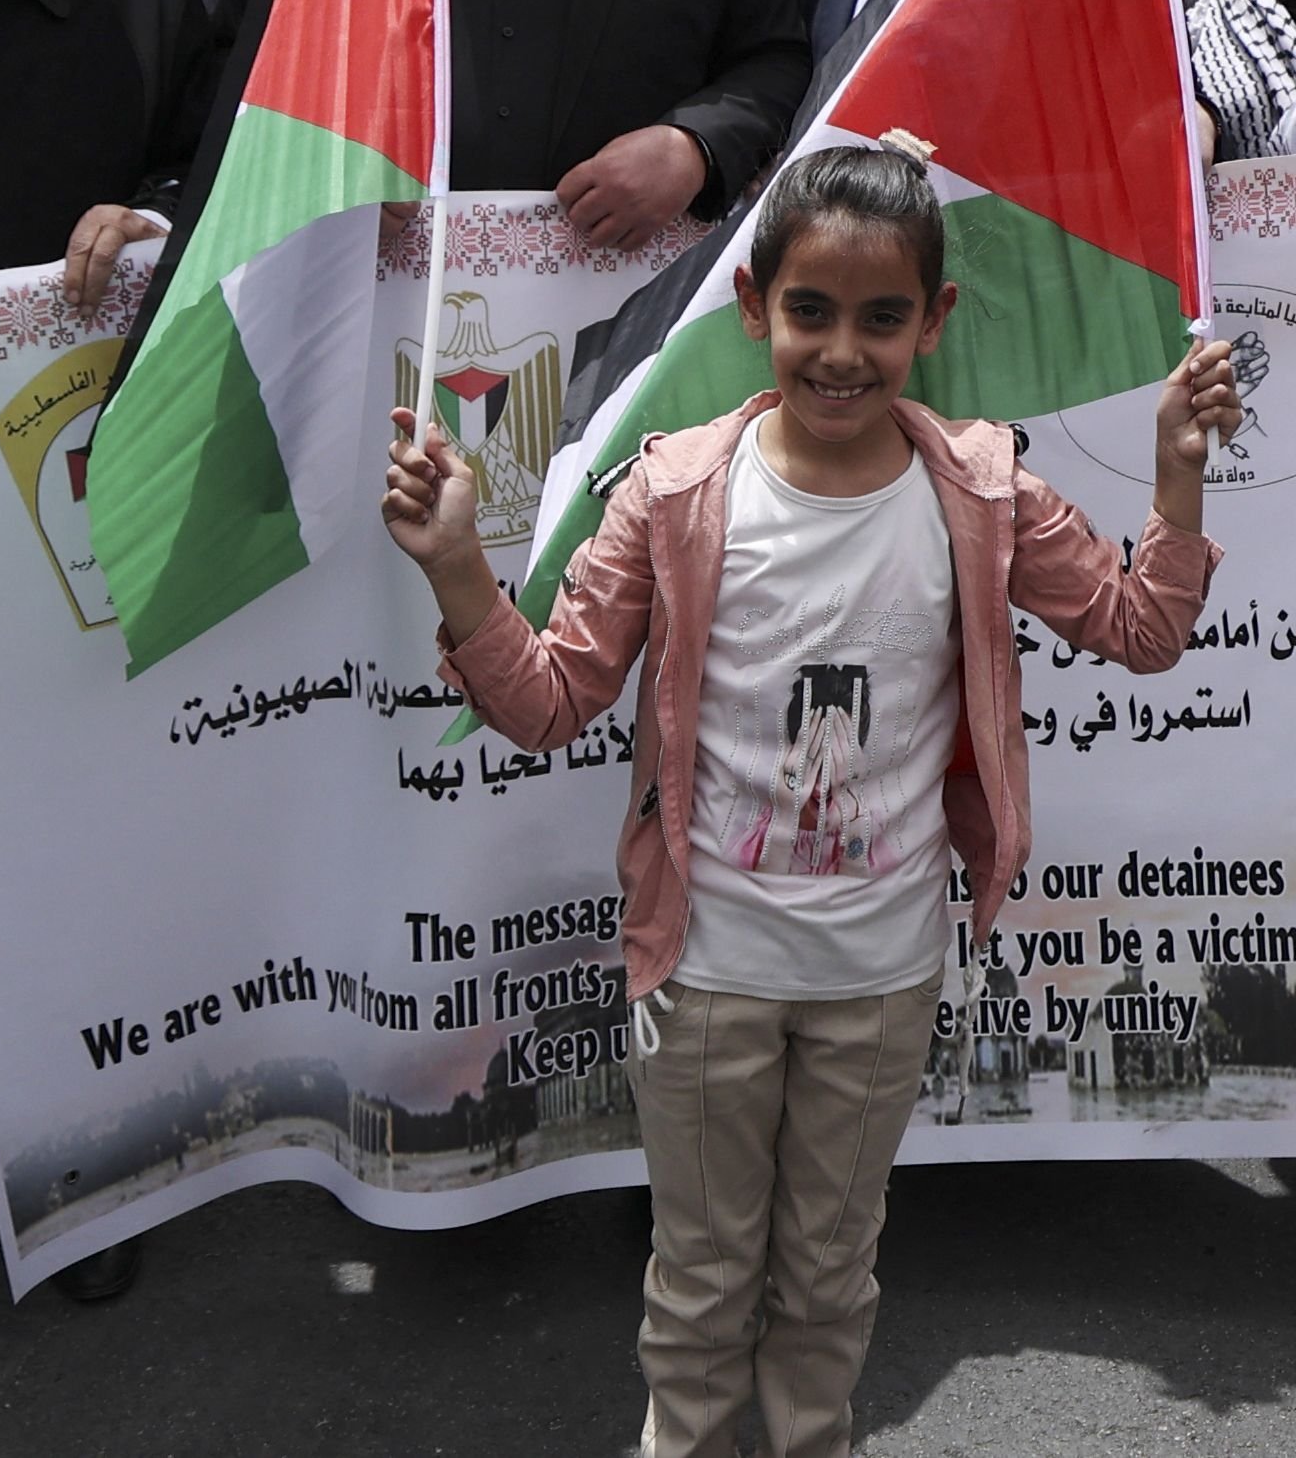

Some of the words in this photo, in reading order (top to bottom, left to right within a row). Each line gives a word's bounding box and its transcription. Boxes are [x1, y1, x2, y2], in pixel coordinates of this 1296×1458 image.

[1225, 297, 1282, 319] لمتابعة
[4, 369, 97, 437] الفلسطينية
[1227, 466, 1255, 484] دولة
[1069, 691, 1116, 753] في
[1128, 687, 1252, 742] استمروا
[397, 745, 465, 803] بهما
[405, 910, 475, 964] The
[1042, 862, 1104, 901] our
[1117, 846, 1285, 898] detainees
[80, 1016, 151, 1071] We
[163, 992, 221, 1043] are
[232, 954, 318, 1016] with
[326, 967, 357, 1013] you
[359, 970, 418, 1034] from
[432, 977, 479, 1032] all
[492, 959, 616, 1022] fronts,
[1016, 927, 1085, 976] you
[1098, 917, 1142, 966] be
[1156, 925, 1176, 964] a
[506, 1029, 595, 1086] Keep
[972, 988, 1031, 1035] ive
[1044, 984, 1089, 1042] by
[1104, 980, 1198, 1042] unity
